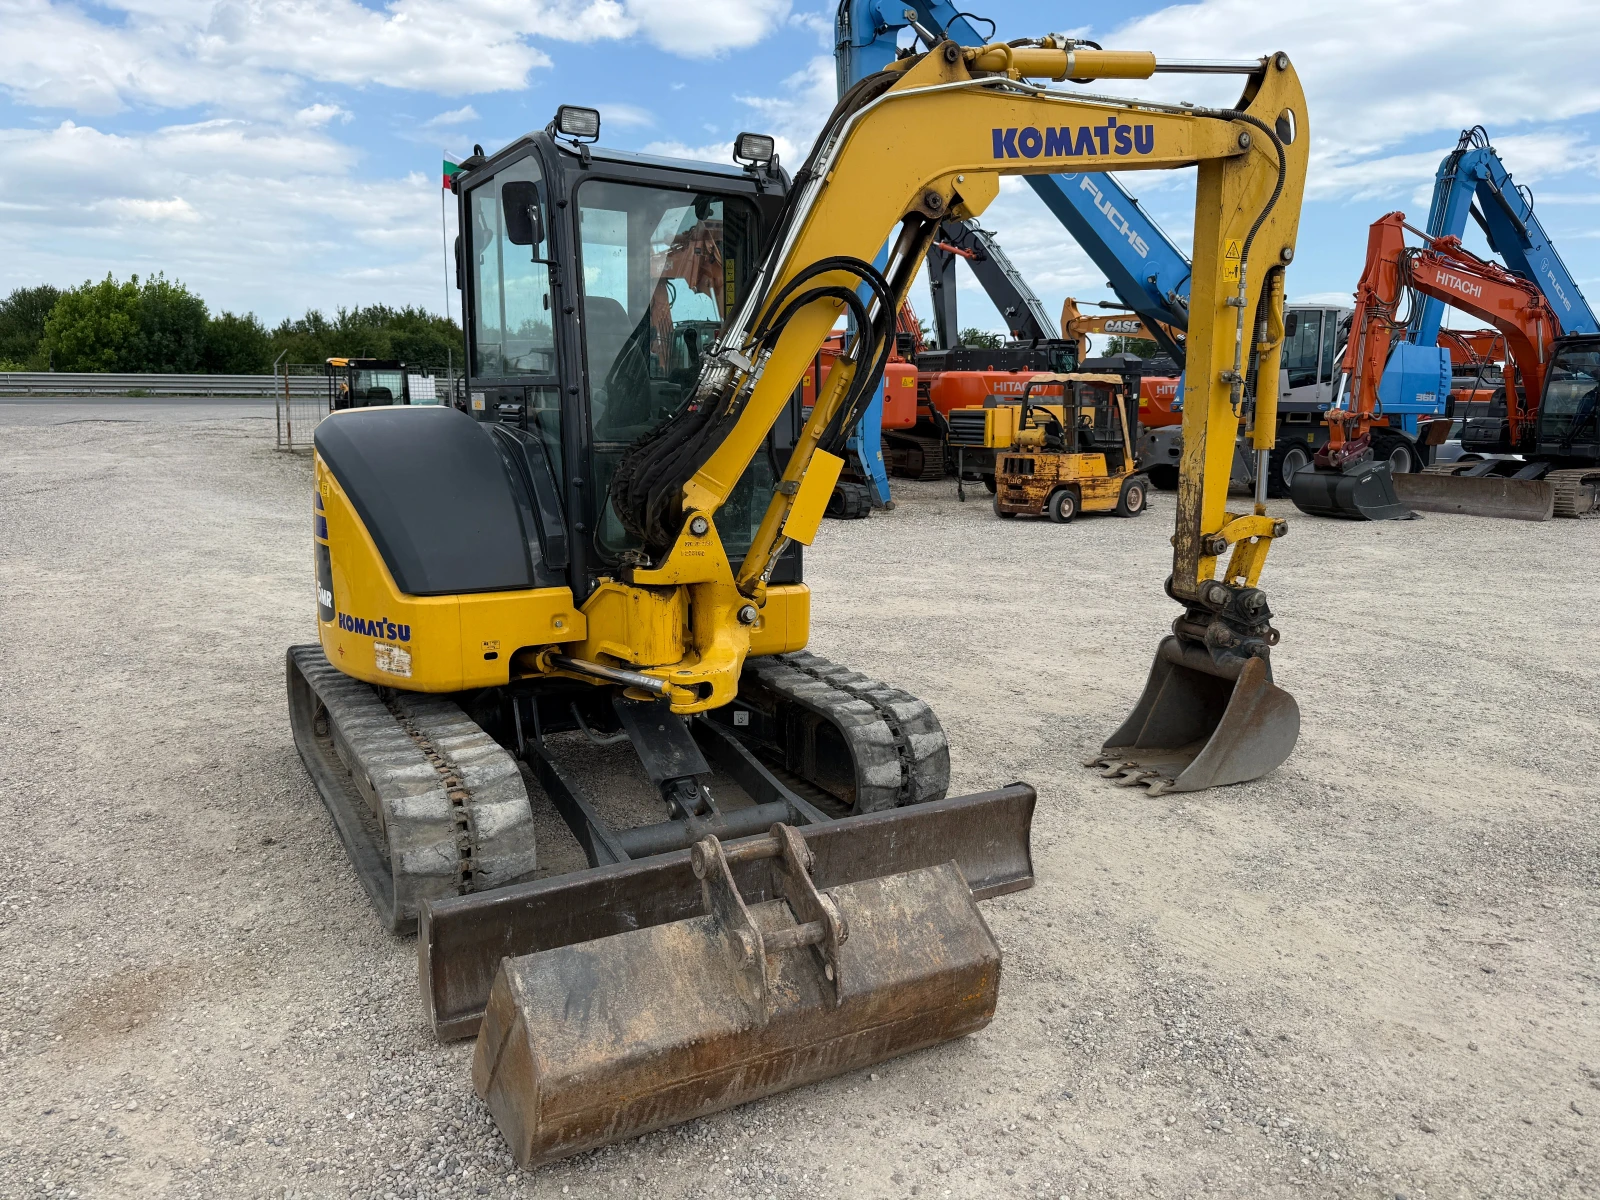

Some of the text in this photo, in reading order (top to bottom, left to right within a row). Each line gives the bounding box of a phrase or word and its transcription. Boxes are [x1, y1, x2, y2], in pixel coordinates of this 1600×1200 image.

[992, 117, 1154, 159] KOMATSU
[1079, 175, 1150, 258] FUCHS
[1436, 271, 1482, 298] HITACHI
[1547, 270, 1572, 312] FUCHS
[1104, 320, 1141, 333] CASE
[1415, 393, 1436, 401] 360
[338, 612, 411, 642] KOMATSU
